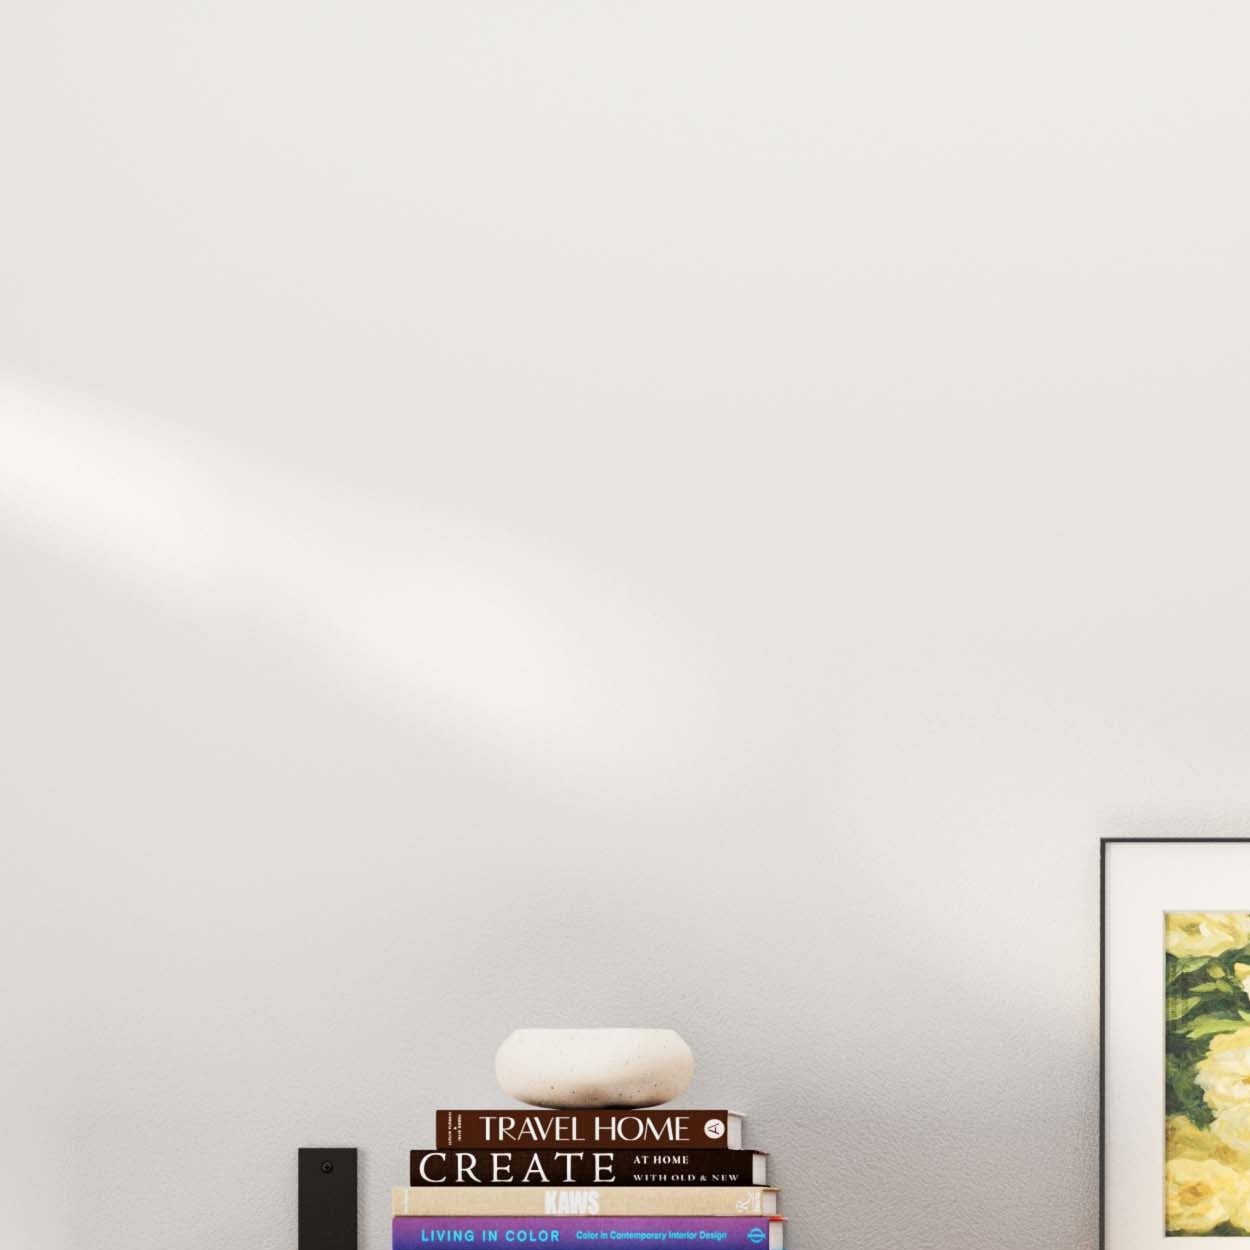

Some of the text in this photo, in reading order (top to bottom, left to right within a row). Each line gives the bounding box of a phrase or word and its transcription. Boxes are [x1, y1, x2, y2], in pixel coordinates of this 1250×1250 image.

[479, 1116, 585, 1141] TRAVEL
[594, 1116, 690, 1141] HOME
[633, 1155, 689, 1165] AT HOME
[419, 1152, 616, 1183] CREATE
[633, 1174, 668, 1182] WITH
[671, 1174, 696, 1182] OLD
[712, 1174, 739, 1182] NEW
[544, 1190, 600, 1215] KAWS
[421, 1229, 560, 1242] LIVING IN COLOR
[576, 1231, 727, 1241] Color in Contemporary Interior Design
